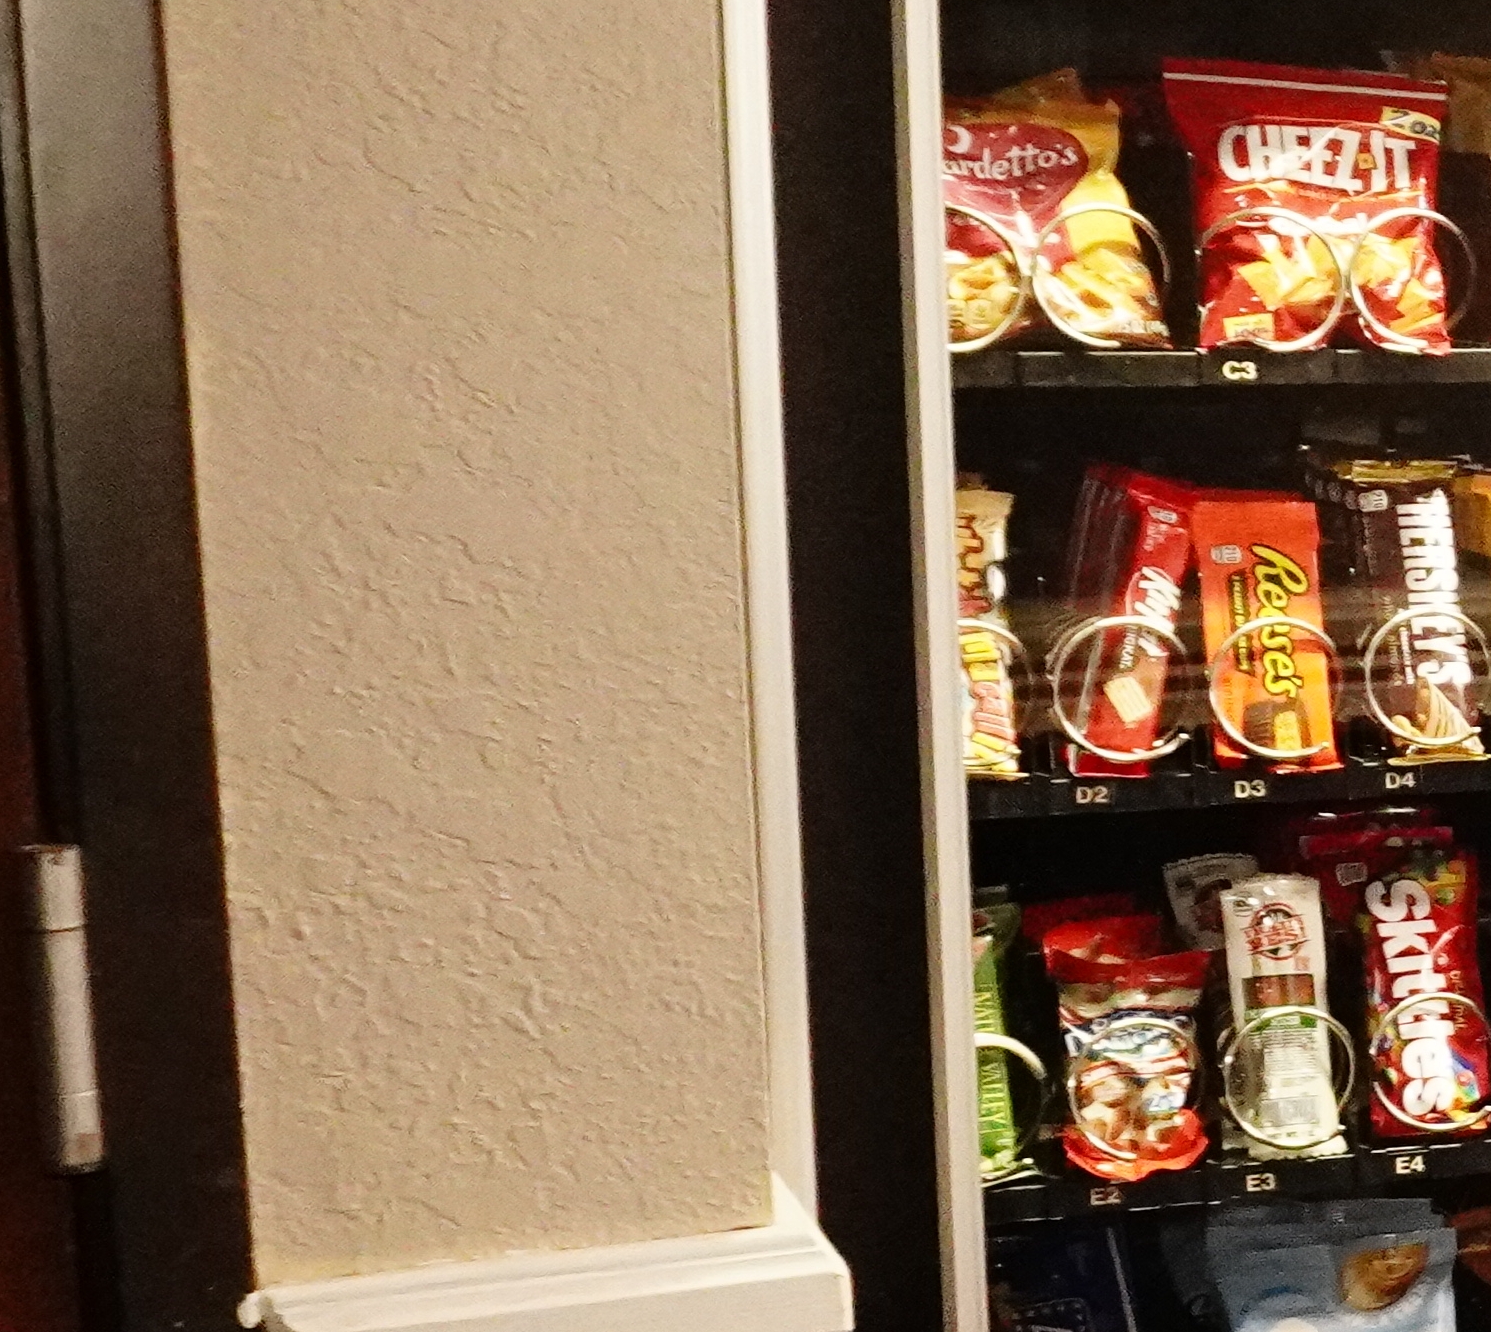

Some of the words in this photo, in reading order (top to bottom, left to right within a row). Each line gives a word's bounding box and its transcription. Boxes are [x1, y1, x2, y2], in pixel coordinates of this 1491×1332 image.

[1223, 360, 1257, 380] C3
[1250, 542, 1310, 699] Reese's
[1234, 780, 1267, 800] D3
[1385, 771, 1416, 791] D4
[1076, 785, 1109, 805] D2
[1364, 879, 1455, 1116] Skittles
[1395, 1155, 1425, 1175] E4
[1245, 1173, 1276, 1193] E3
[1090, 1186, 1123, 1206] E2
